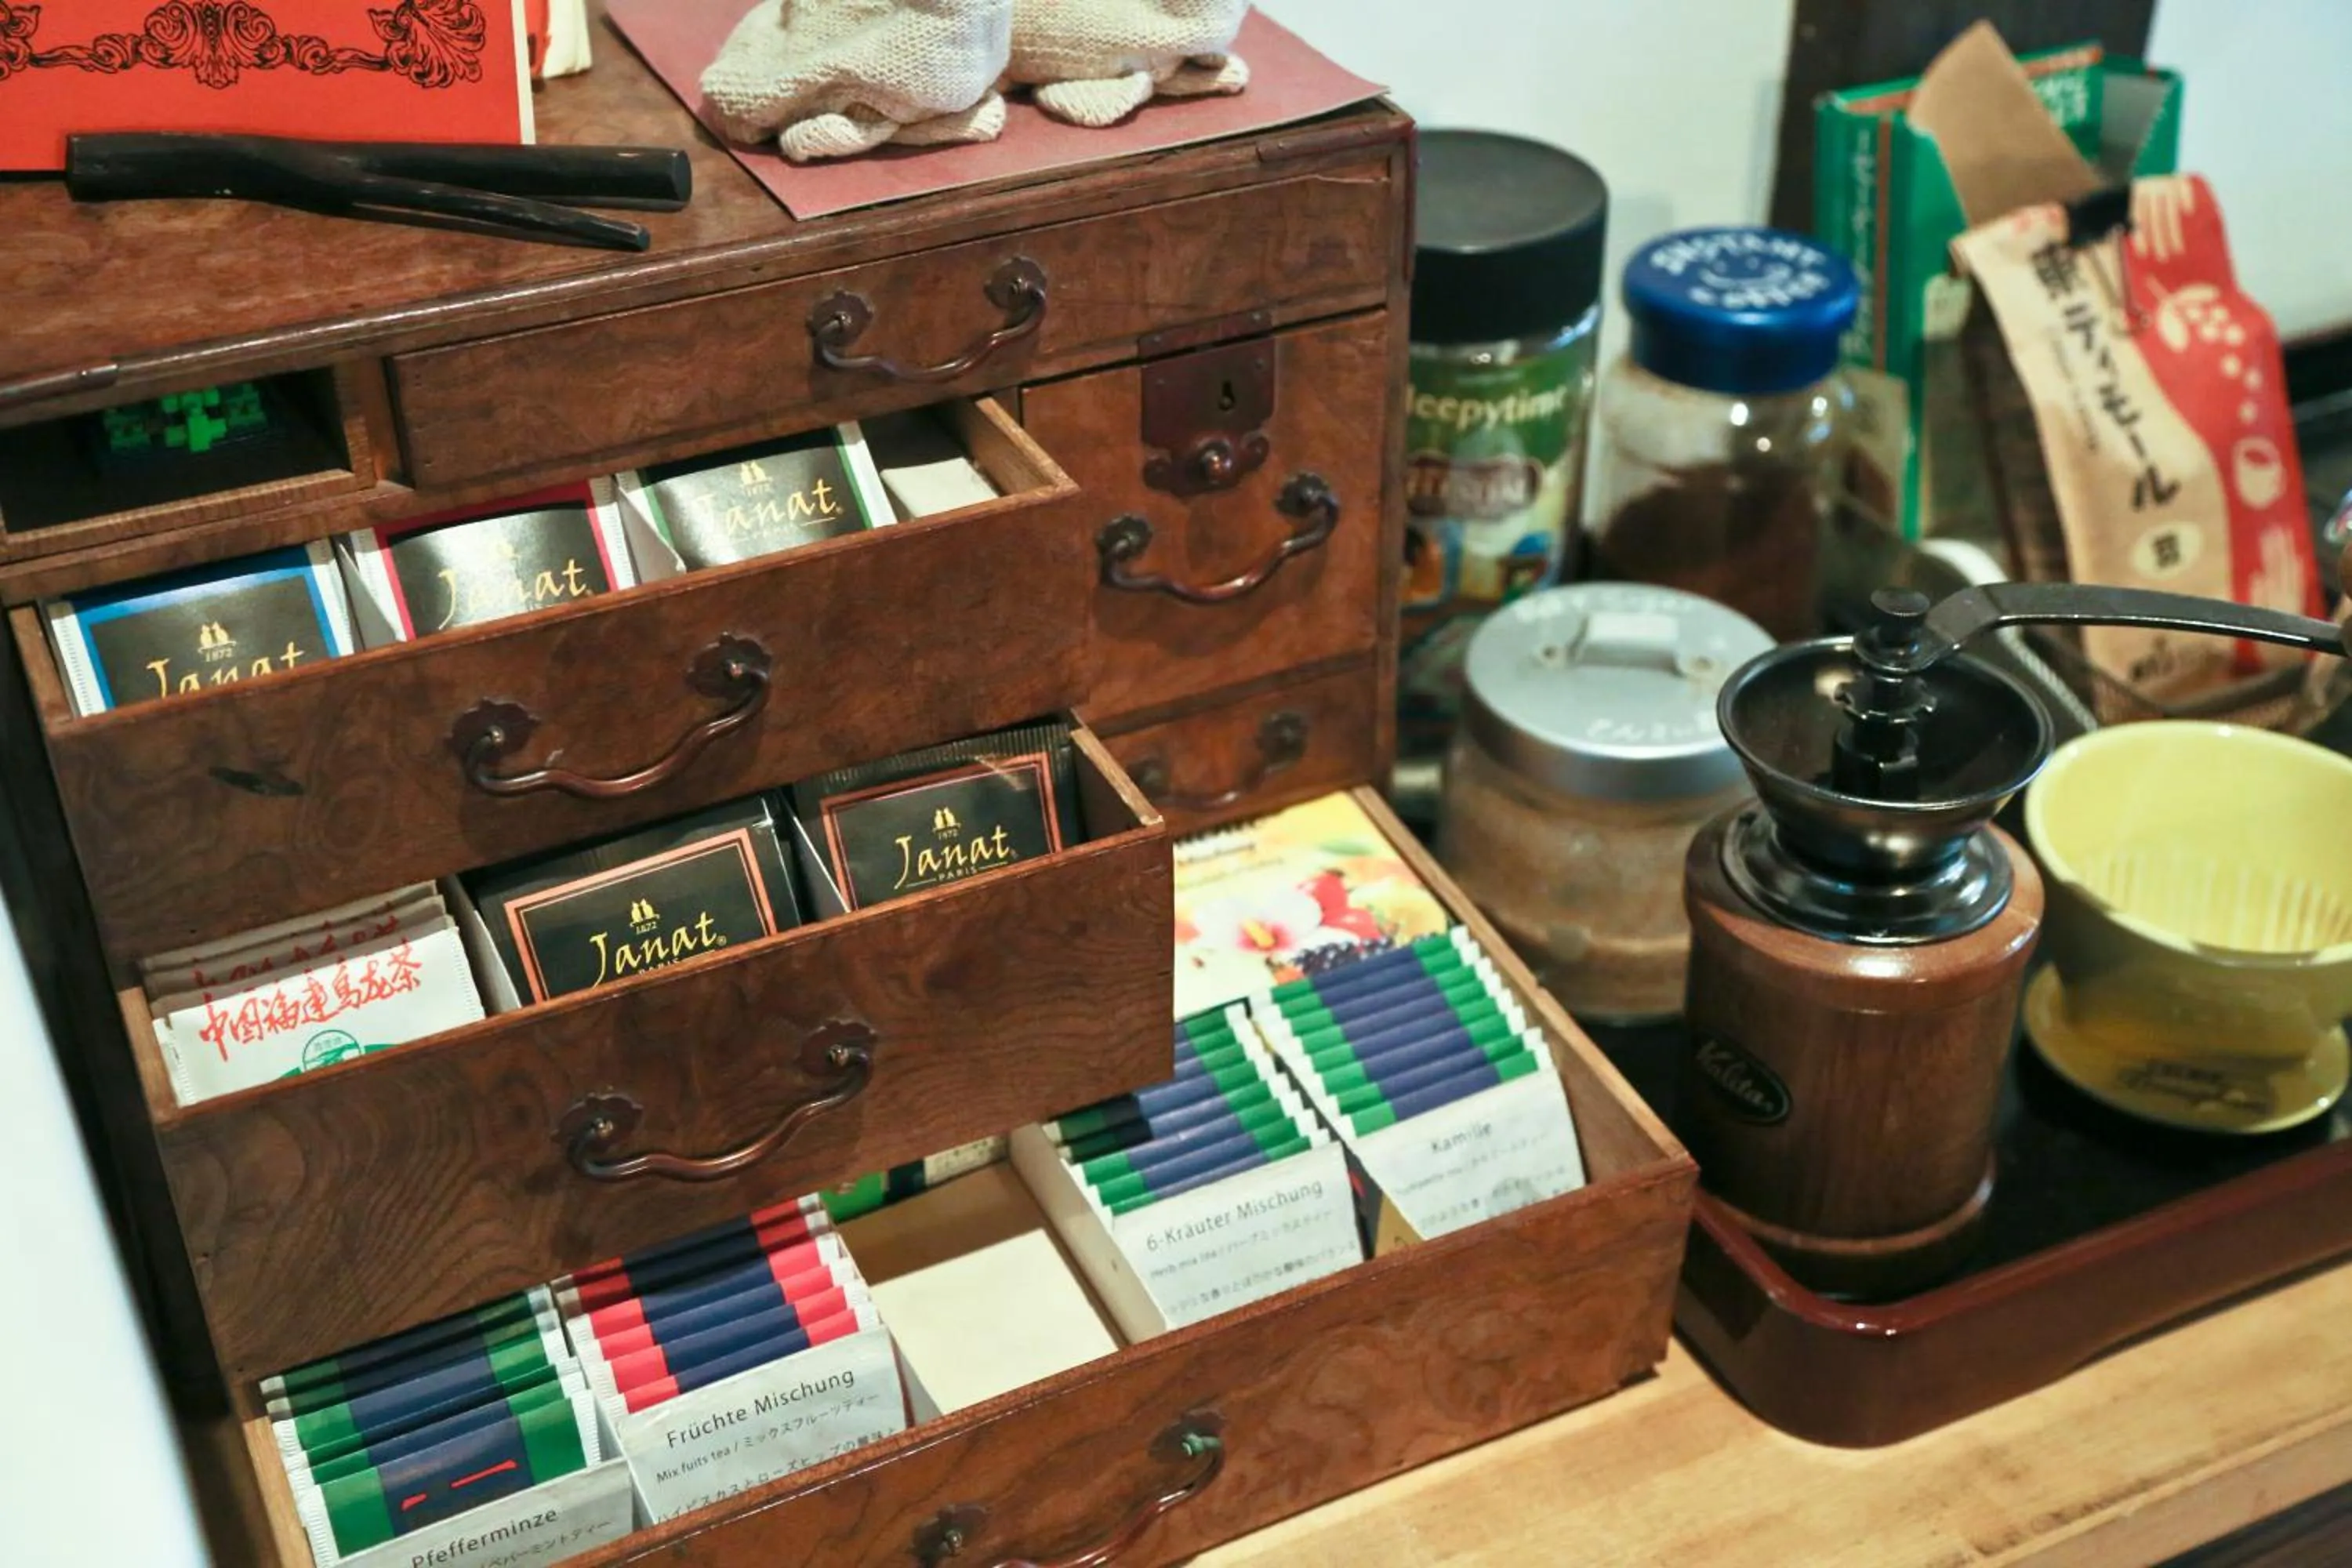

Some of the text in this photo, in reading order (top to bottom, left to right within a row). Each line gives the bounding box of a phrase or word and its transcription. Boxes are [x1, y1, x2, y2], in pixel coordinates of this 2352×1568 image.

[693, 478, 837, 549] Janat
[438, 558, 586, 630] Janat
[147, 641, 305, 699] Janat
[894, 824, 1009, 890] Janat
[938, 866, 978, 881] PARIS
[590, 911, 717, 989] Janat
[636, 921, 657, 935] 1872
[1146, 1180, 1323, 1251] 6-Kräuter Mischung
[667, 1370, 855, 1449] Früchte Mischung
[656, 1468, 680, 1483] Mix
[710, 1446, 731, 1461] tea
[412, 1508, 558, 1568] Pfefferminze
